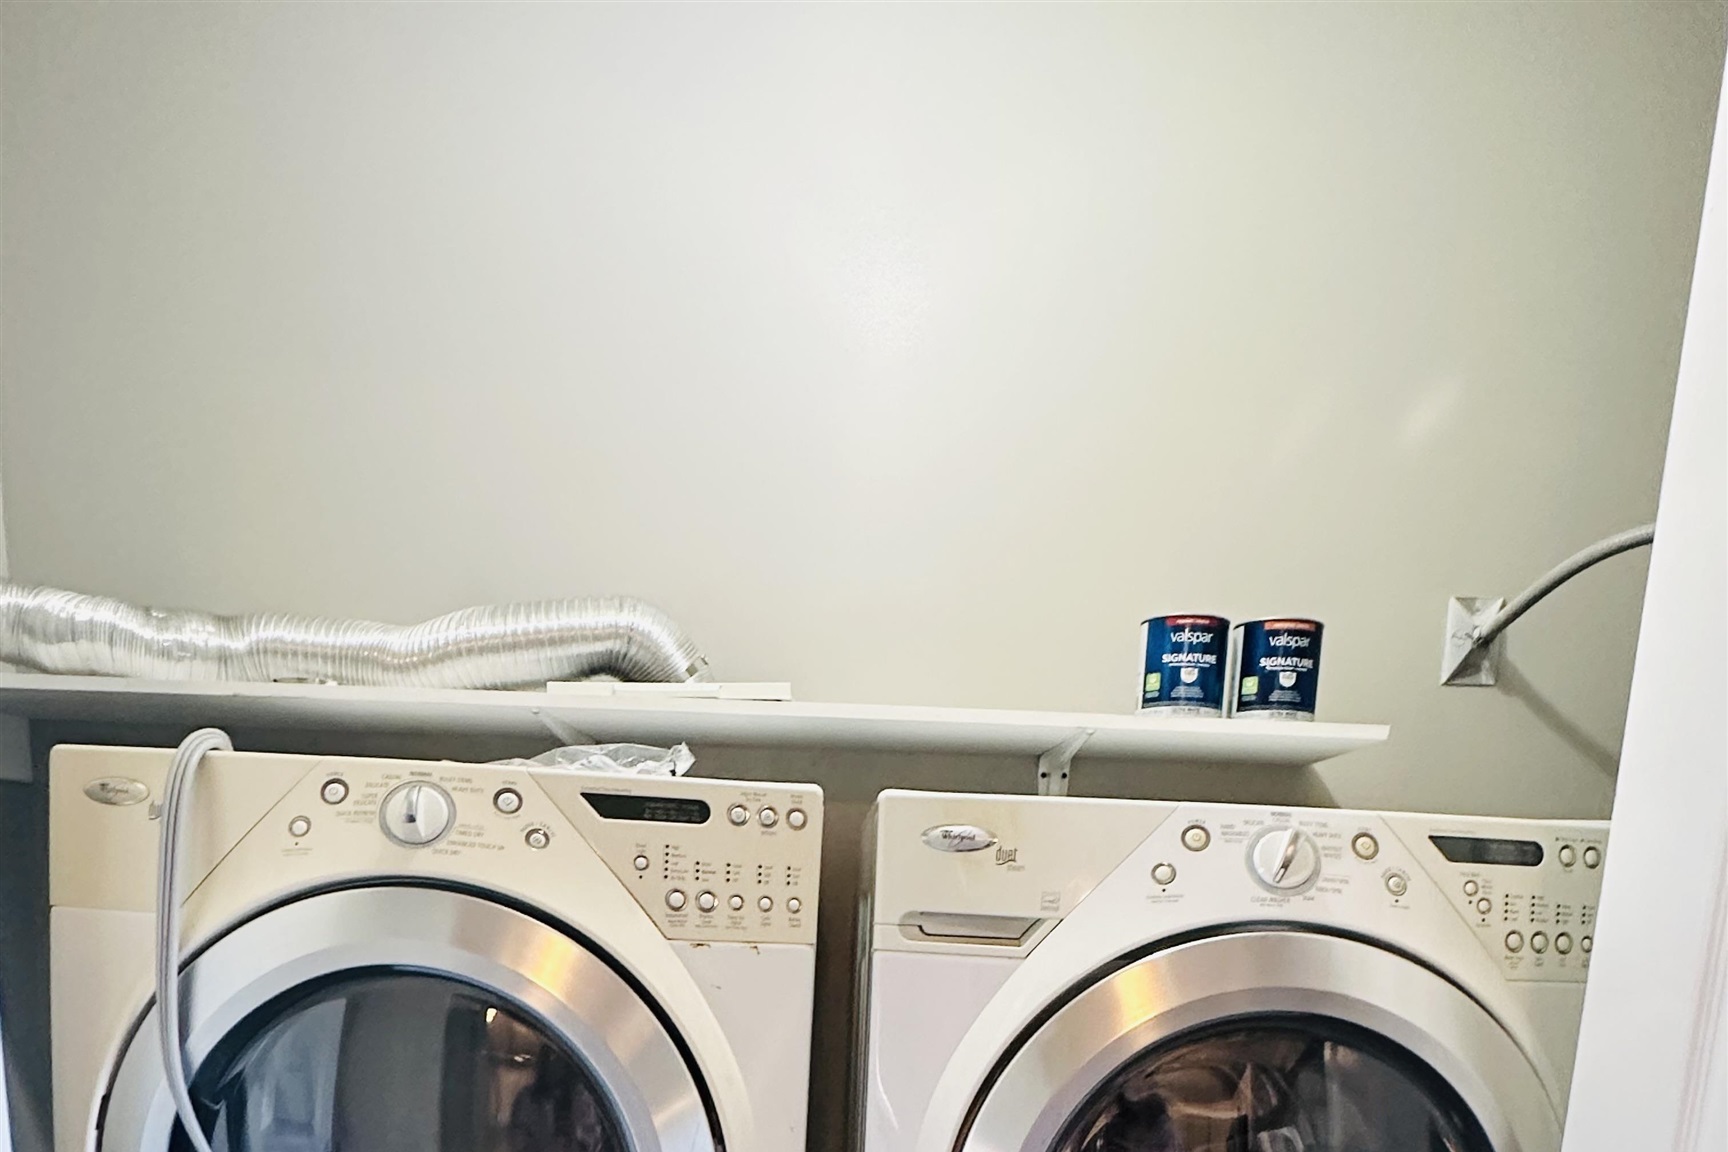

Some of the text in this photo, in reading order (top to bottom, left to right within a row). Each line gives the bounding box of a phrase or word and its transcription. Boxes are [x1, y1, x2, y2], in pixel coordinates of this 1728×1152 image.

[1170, 628, 1214, 645] valspar
[1268, 632, 1311, 650] valspar
[1161, 652, 1218, 664] SIGNATURE
[1259, 656, 1315, 669] SIGNATURE
[995, 846, 1018, 865] duet
